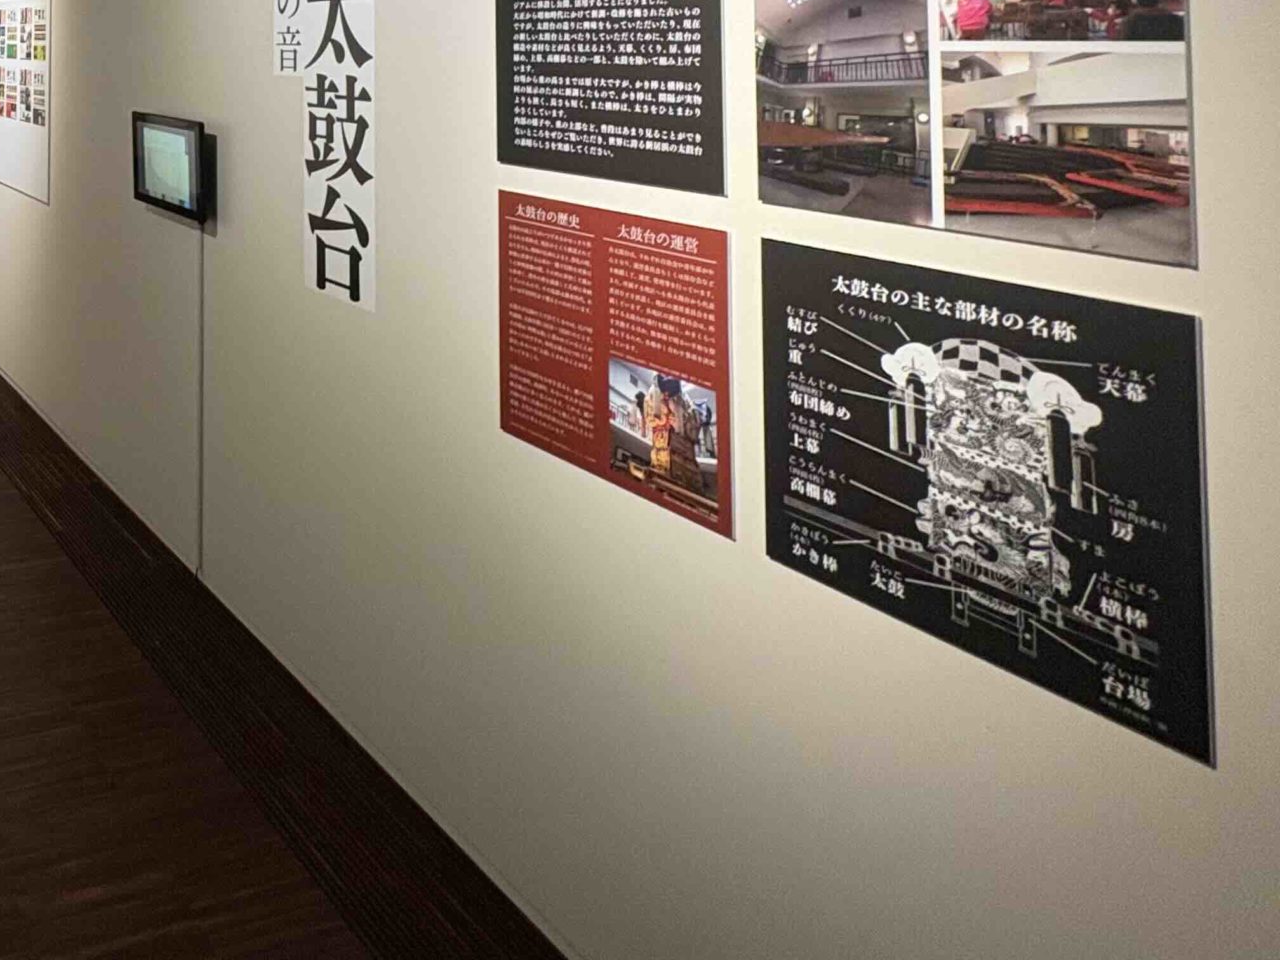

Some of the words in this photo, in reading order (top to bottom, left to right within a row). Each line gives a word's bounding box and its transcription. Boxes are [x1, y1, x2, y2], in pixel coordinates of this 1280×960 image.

[514, 202, 582, 230] 太鼓台の歴史
[617, 223, 700, 254] 太鼓台の運営
[785, 303, 818, 321] むすび
[831, 275, 1078, 344] 太鼓台の主な部材の名称
[786, 314, 818, 337] 結び
[786, 336, 815, 354] じゅう
[787, 346, 803, 366] 重
[1097, 373, 1148, 406] 天幕
[788, 387, 851, 423] 布団締め
[788, 410, 827, 434] うわまく
[789, 430, 821, 457] 上幕
[788, 453, 847, 486] こうらんまく
[789, 474, 837, 508] 高欄幕
[790, 519, 830, 548] かきぼう
[1108, 515, 1133, 544] 房
[791, 538, 838, 575] かき棒
[870, 558, 902, 582] たいこ
[869, 568, 905, 600] 太鼓
[1098, 592, 1148, 631] 横棒
[1101, 670, 1152, 713] 台場
